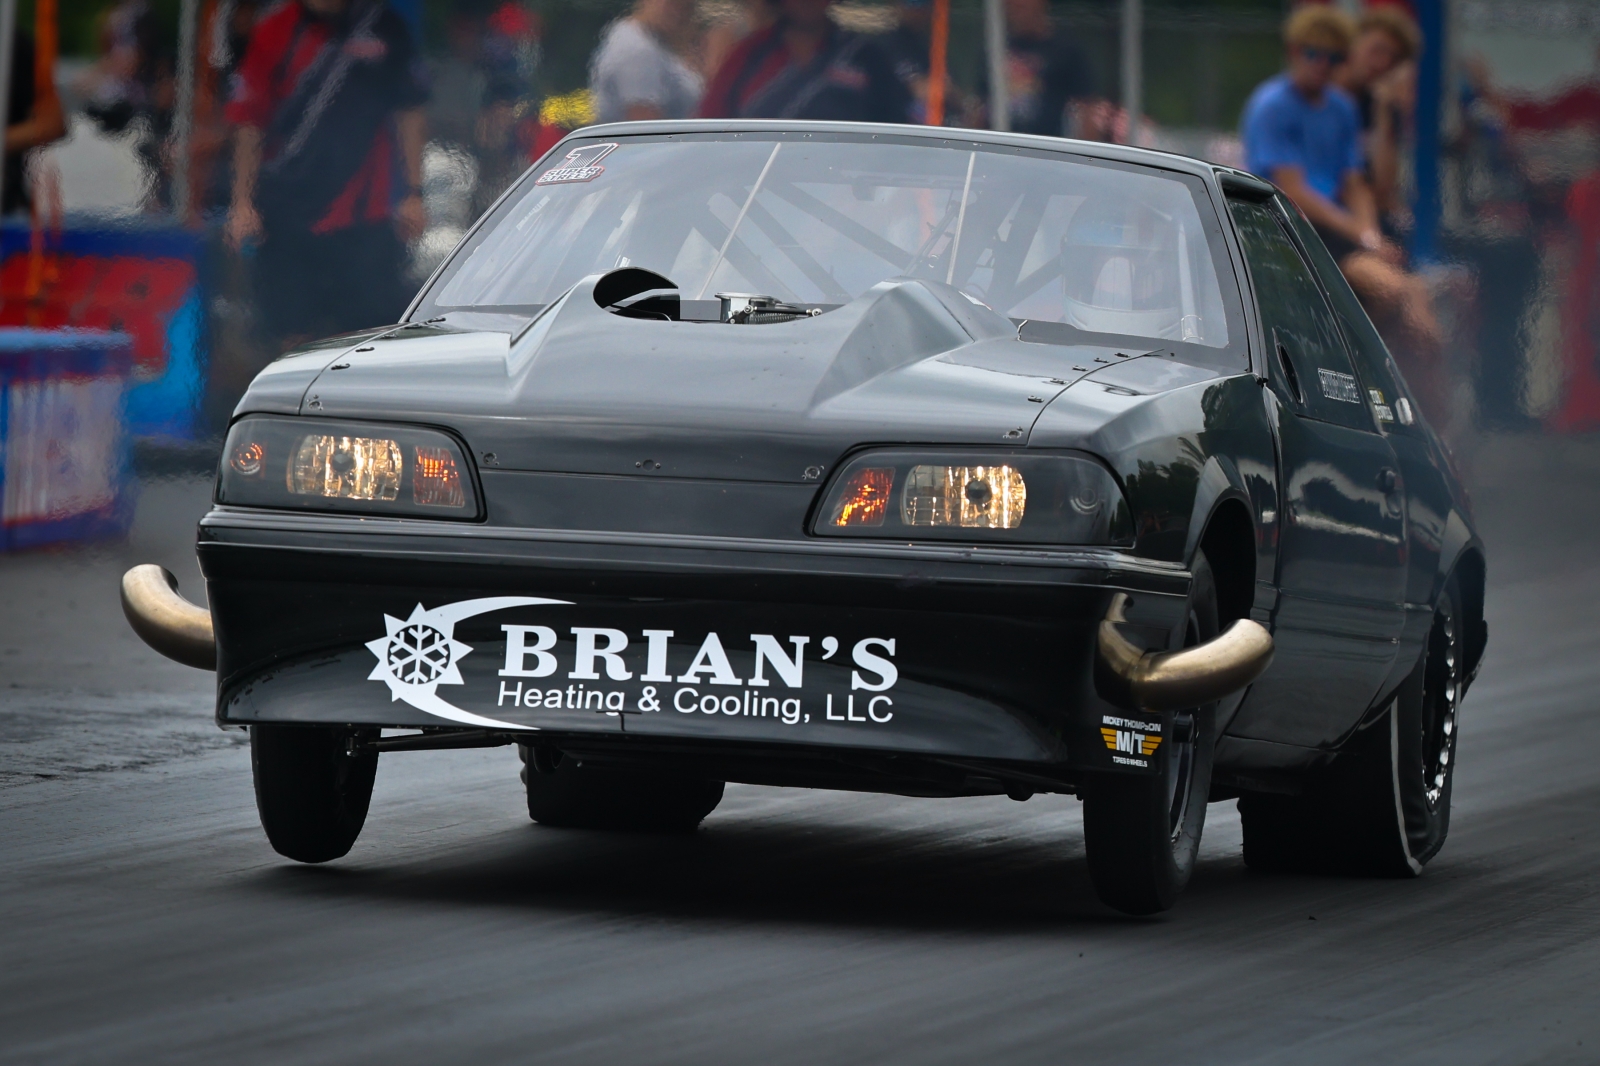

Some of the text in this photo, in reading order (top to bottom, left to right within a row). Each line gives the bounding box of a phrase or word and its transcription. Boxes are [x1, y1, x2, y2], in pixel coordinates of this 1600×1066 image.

[545, 167, 601, 177] SUPER
[498, 624, 899, 692] BRIAN'S
[497, 681, 893, 724] Heating & Cooling, LLC
[1102, 715, 1162, 732] MICKEY THOMPSON
[1116, 730, 1146, 755] M/T
